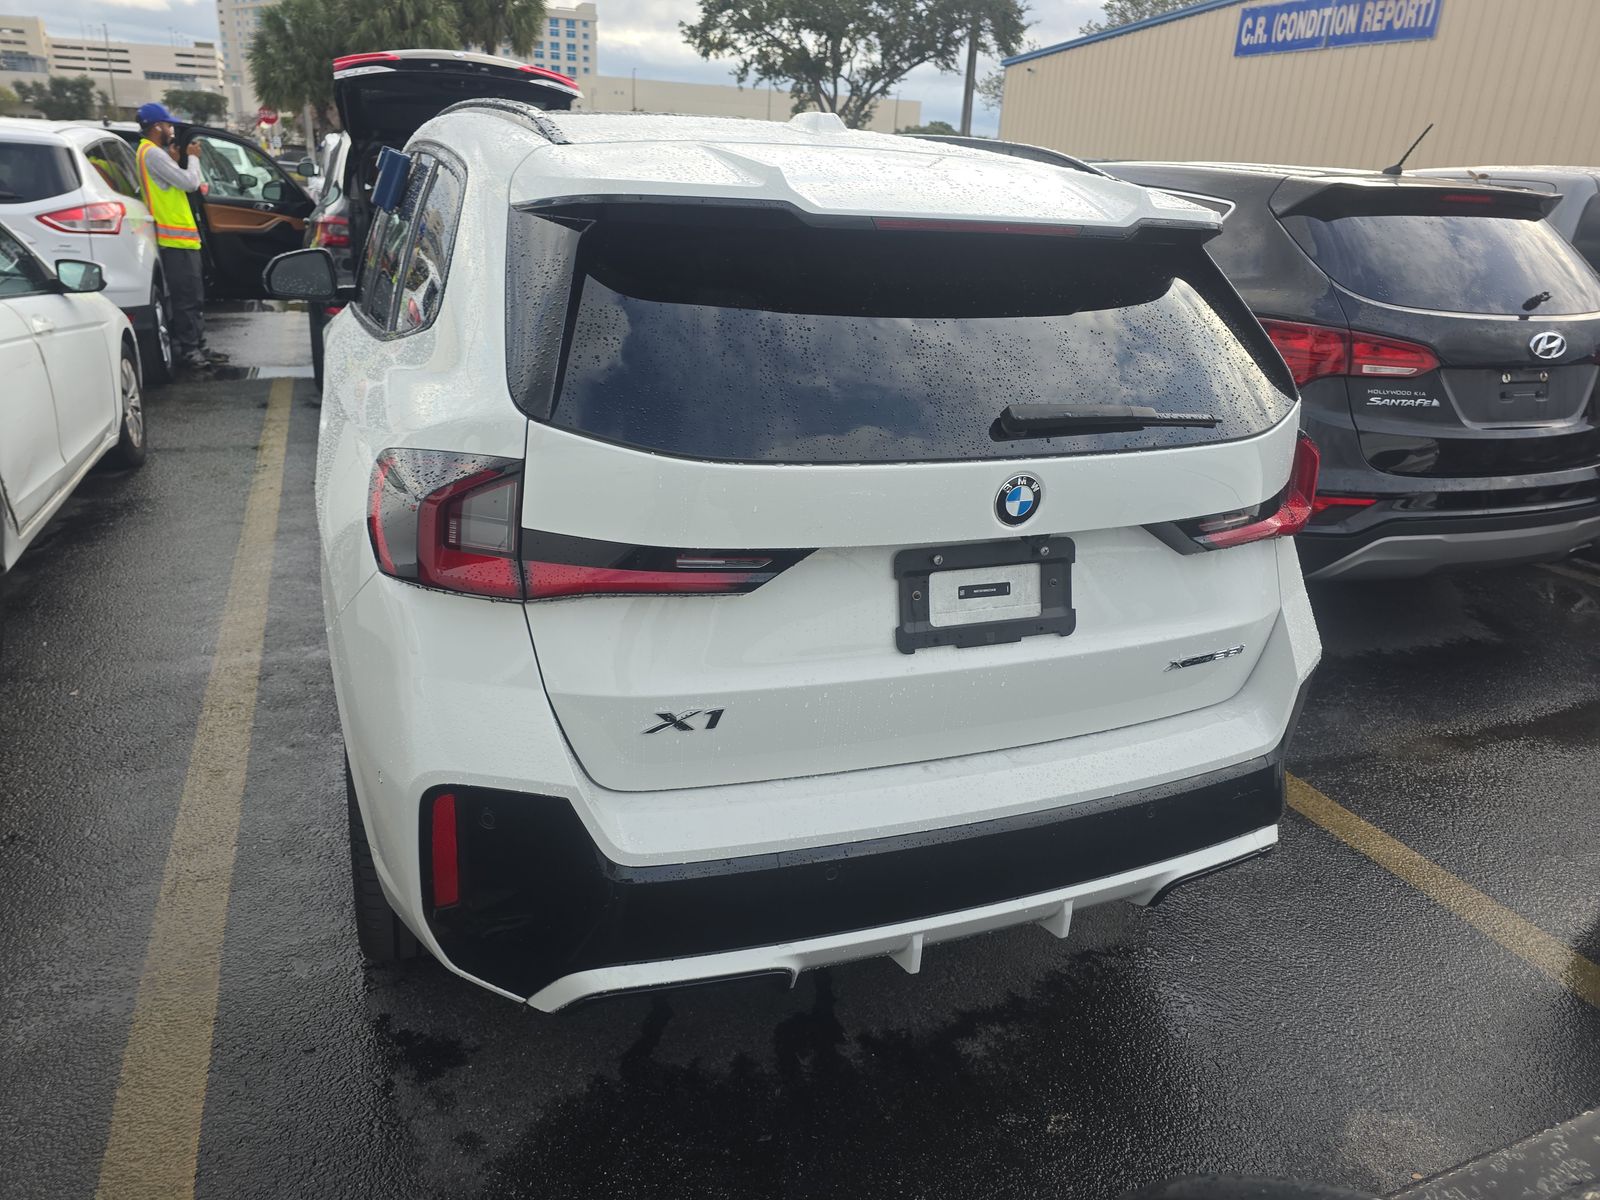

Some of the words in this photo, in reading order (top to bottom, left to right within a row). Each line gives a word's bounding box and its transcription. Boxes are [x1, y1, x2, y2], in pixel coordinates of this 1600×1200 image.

[1241, 16, 1268, 46] C.R.
[1271, 3, 1361, 43] (CONDITION
[1360, 0, 1434, 33] REPORT)
[641, 708, 725, 735] X1
